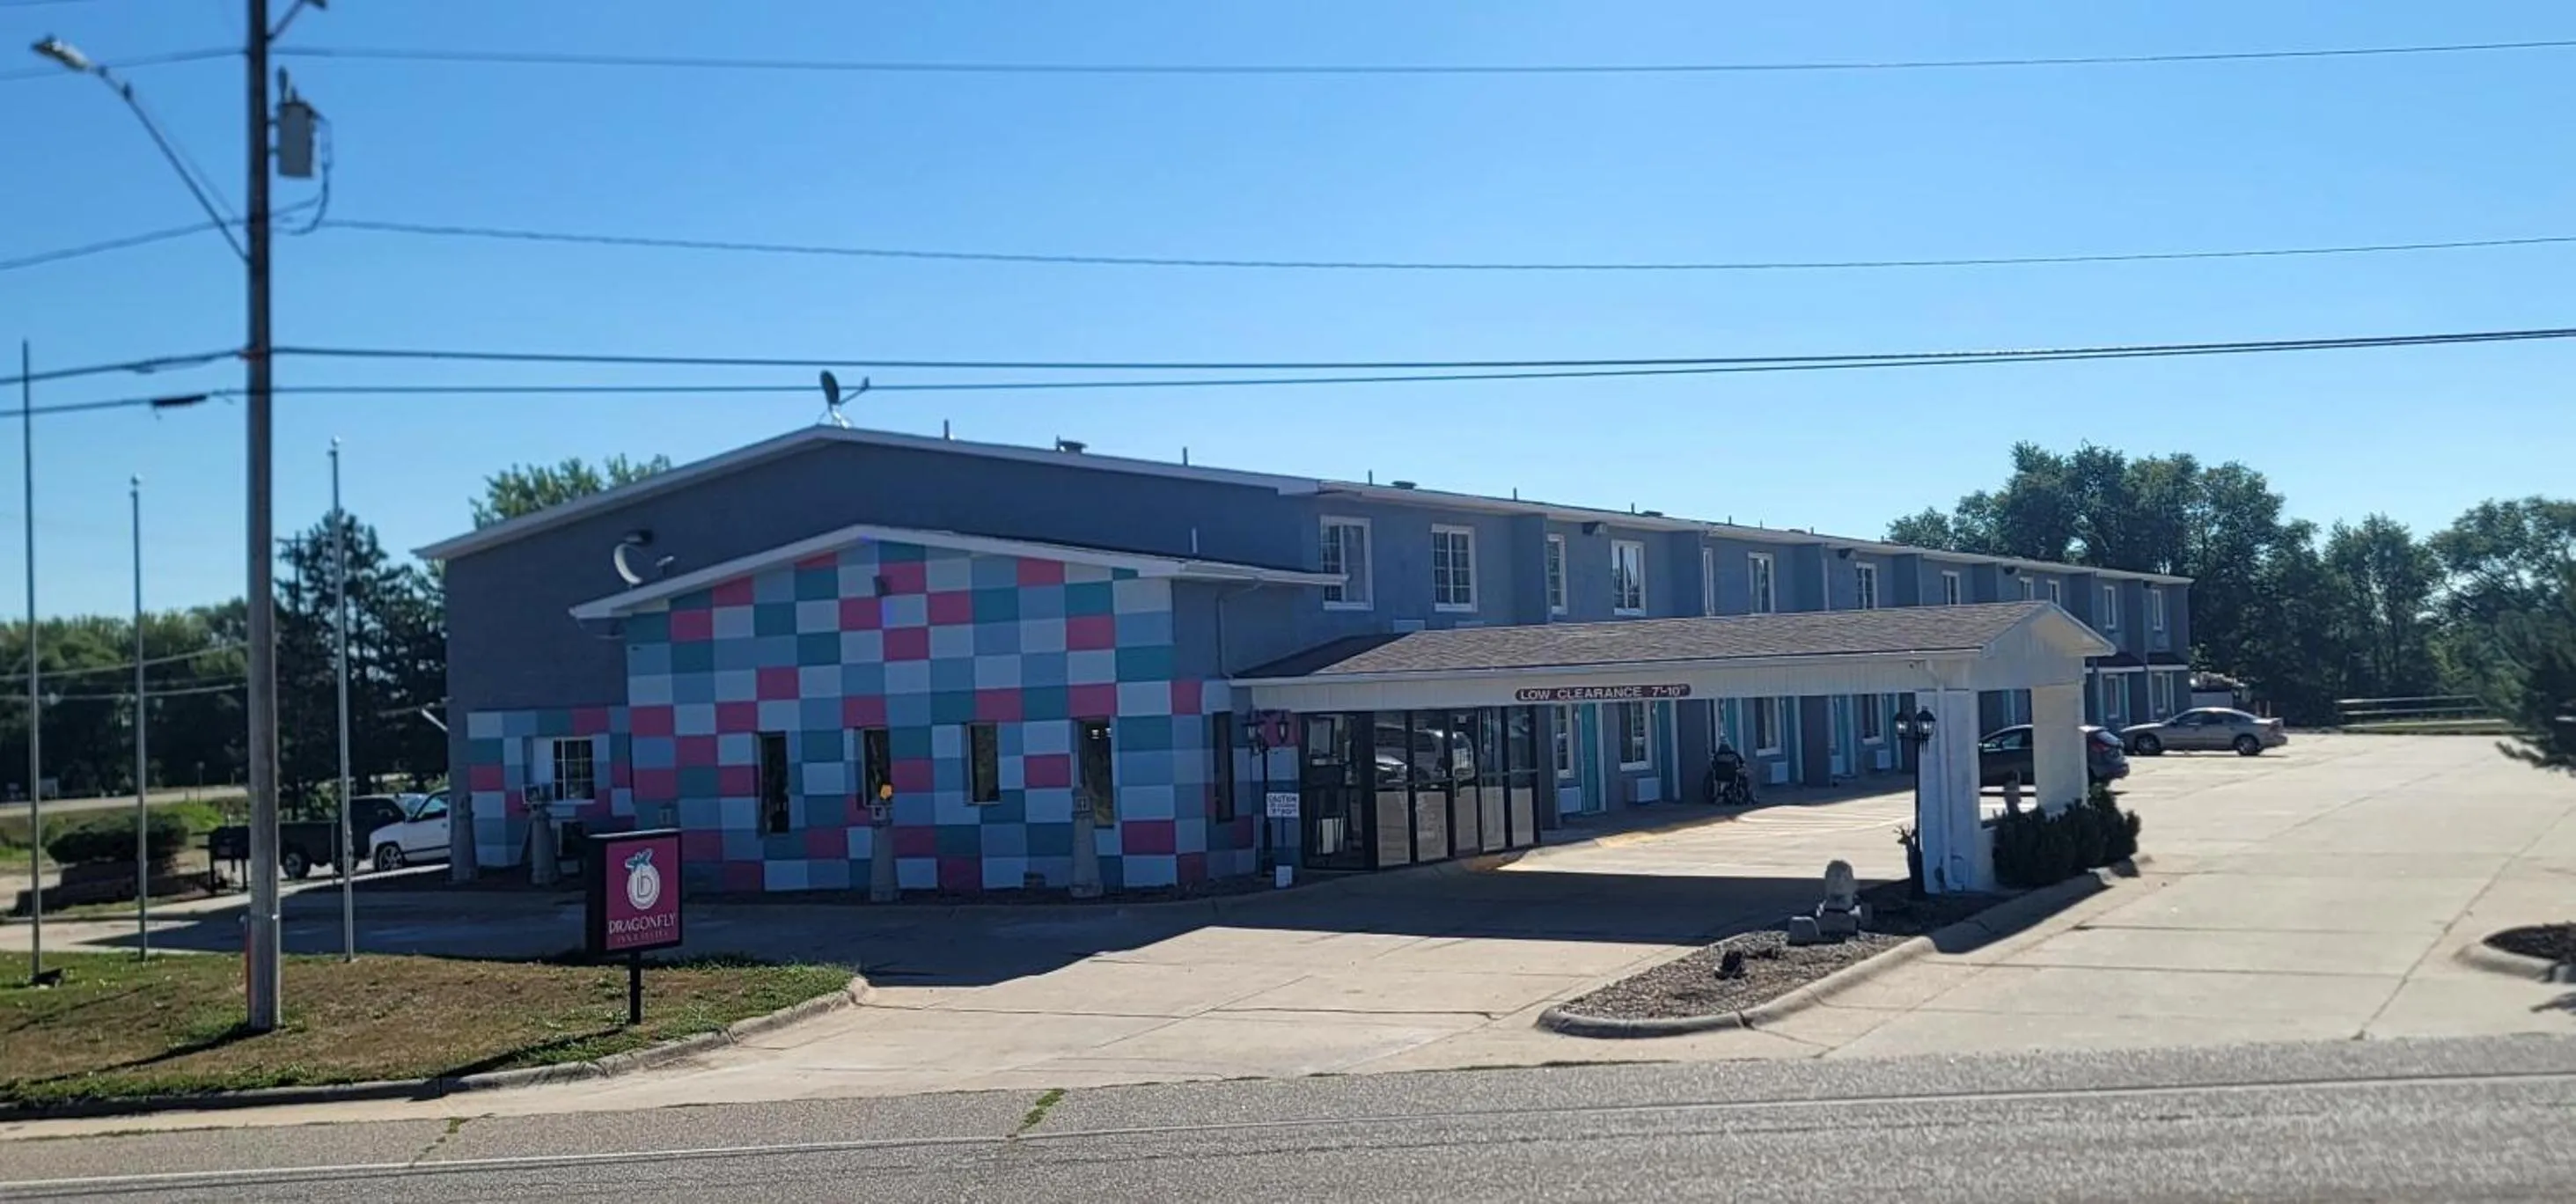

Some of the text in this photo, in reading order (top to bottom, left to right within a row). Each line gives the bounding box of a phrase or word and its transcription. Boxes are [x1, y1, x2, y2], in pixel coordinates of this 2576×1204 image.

[1520, 690, 1550, 701] LOW
[1556, 686, 1642, 701] CLEARANCE
[608, 912, 676, 936] DRAGONFLY
